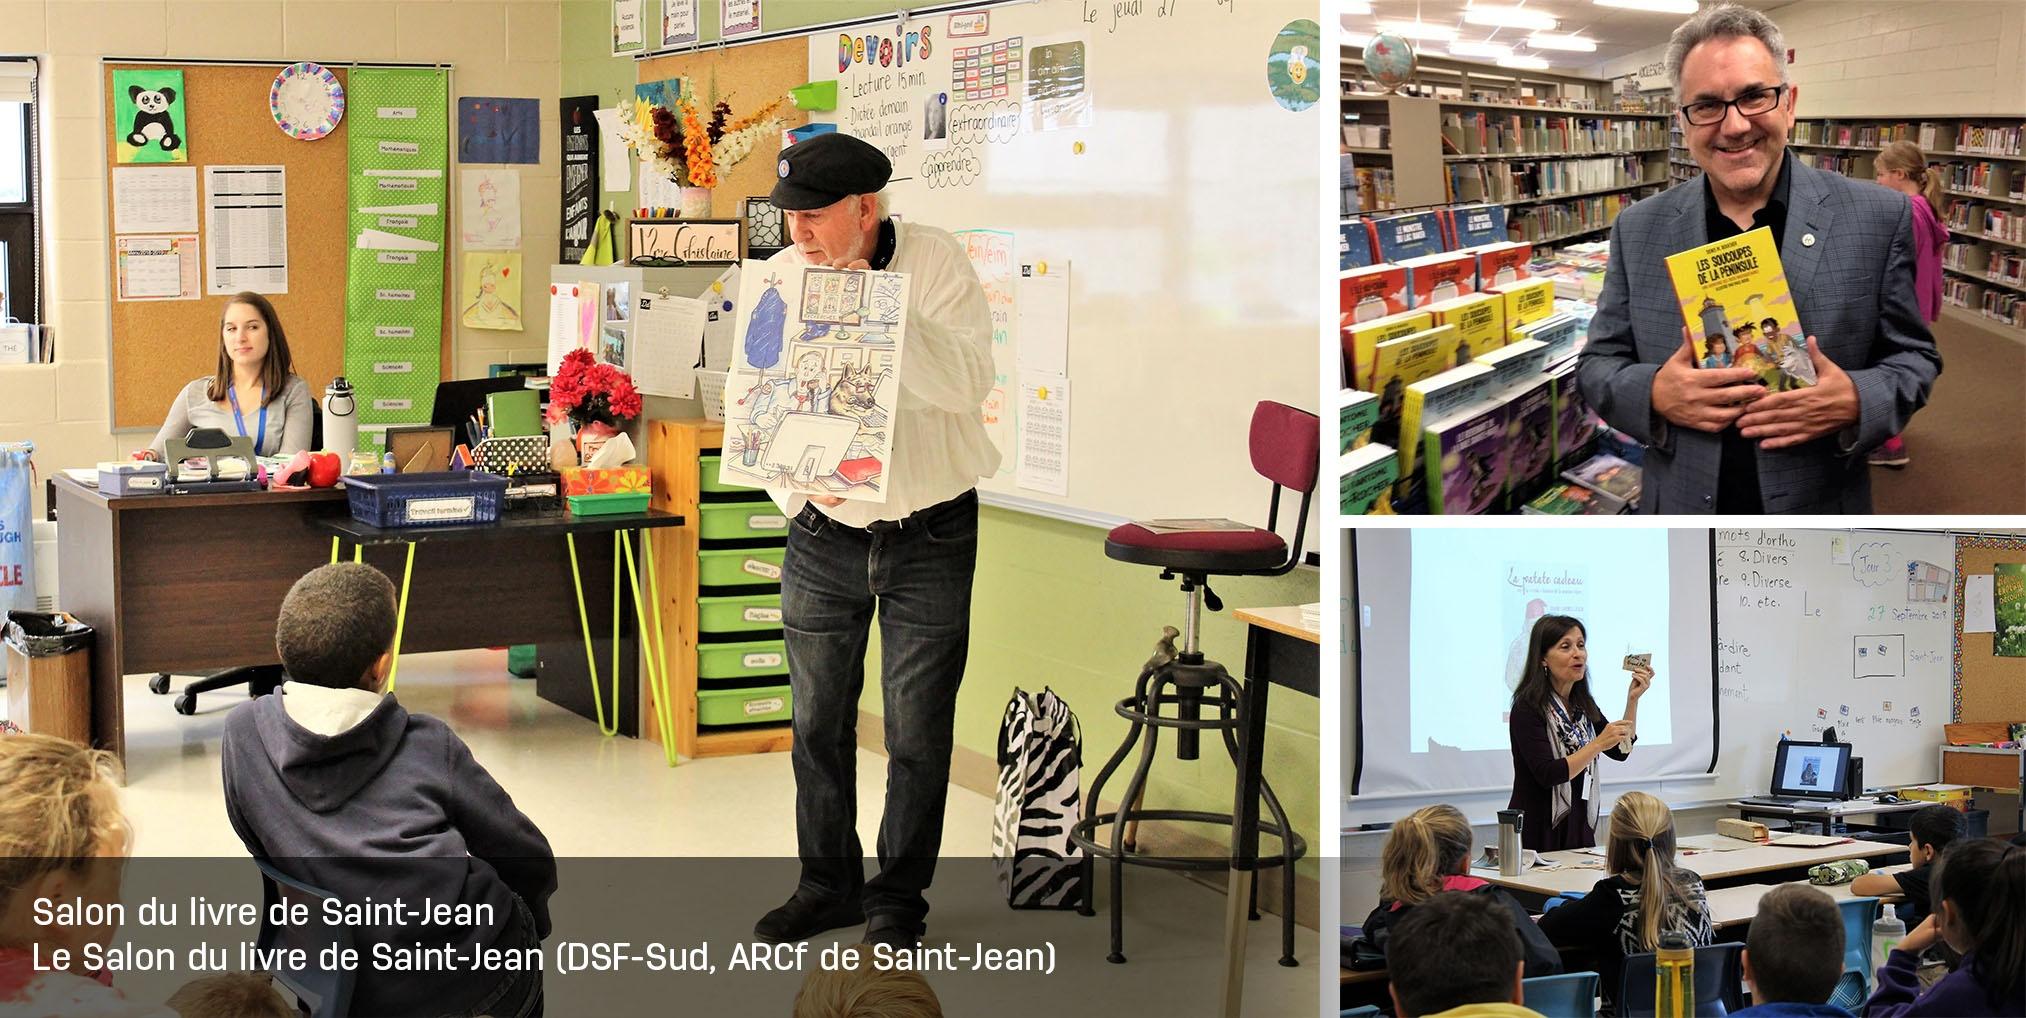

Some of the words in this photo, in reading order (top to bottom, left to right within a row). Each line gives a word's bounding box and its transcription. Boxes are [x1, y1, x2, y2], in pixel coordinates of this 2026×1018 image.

[1083, 1, 1098, 23] Le
[839, 25, 932, 73] Devoirs
[852, 72, 891, 98] Lecture
[897, 72, 908, 90] 15
[878, 97, 909, 119] demain
[884, 119, 913, 140] orange
[953, 112, 1017, 133] extraordinaire
[926, 154, 973, 177] apprendre
[674, 225, 737, 260] Ghislaine
[1696, 258, 1711, 272] LES
[1711, 245, 1753, 267] SOUCOUPES
[1697, 272, 1709, 285] DE
[1709, 269, 1721, 281] LA
[1718, 529, 1751, 541] mots
[1757, 530, 1796, 548] d'ortho
[1752, 549, 1788, 566] Divers
[1522, 571, 1551, 596] patate
[1553, 570, 1584, 585] cadeau
[1752, 570, 1793, 588] Diverse
[1757, 595, 1781, 608] etc.
[1868, 606, 1886, 621] 27
